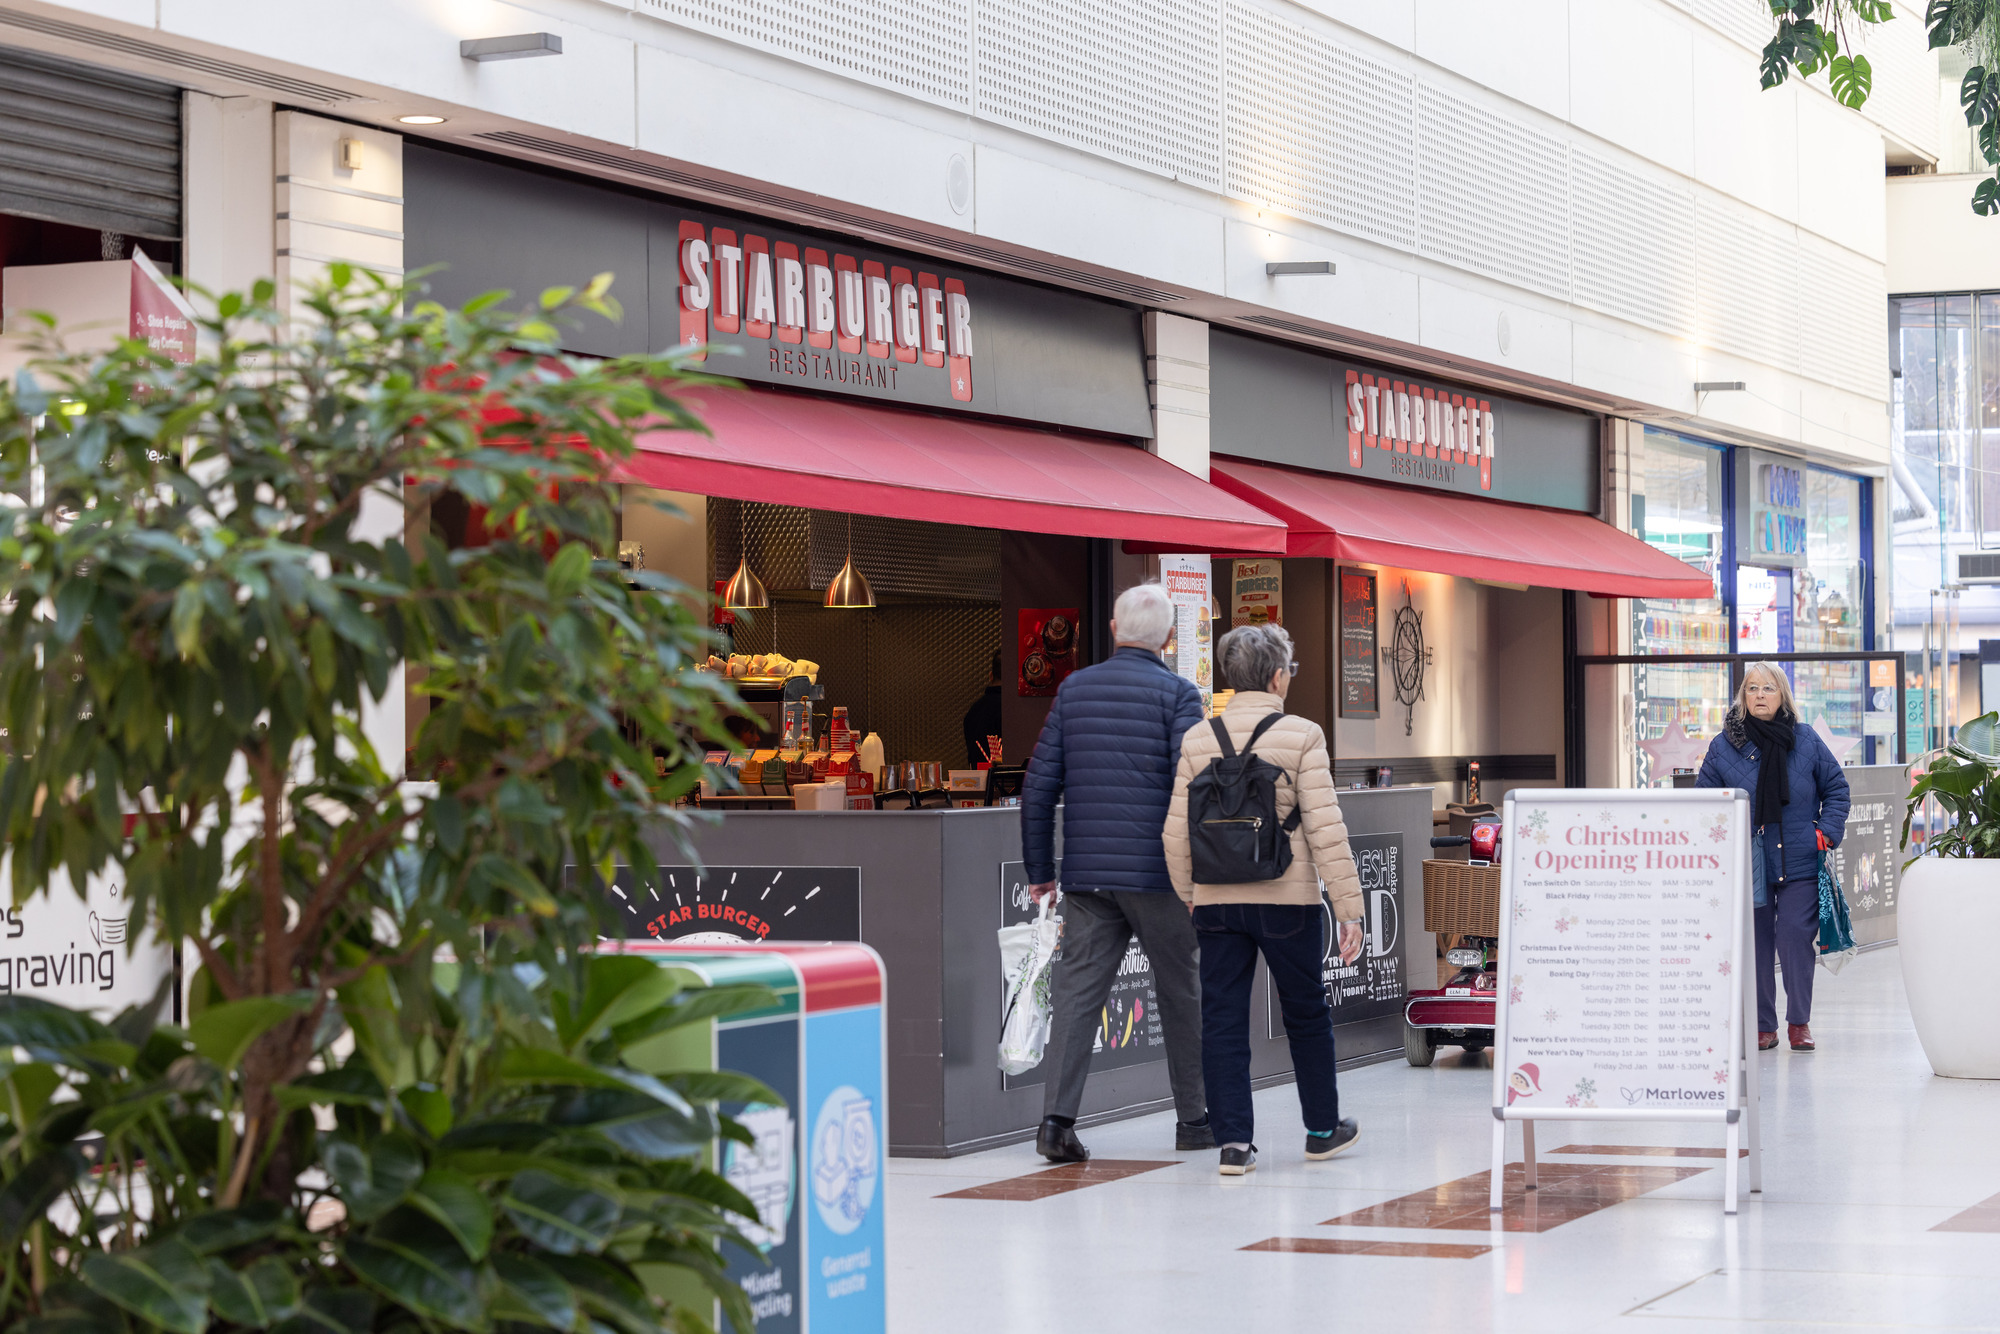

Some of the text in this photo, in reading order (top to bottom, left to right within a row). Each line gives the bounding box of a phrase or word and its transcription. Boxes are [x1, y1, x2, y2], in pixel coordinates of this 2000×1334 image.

[681, 238, 974, 357] STARBURGER
[148, 314, 187, 331] Shoe Repairs
[148, 336, 183, 351] Key Cutting
[769, 348, 899, 391] RESTAURANT
[1347, 381, 1495, 458] STARBURGER
[1391, 456, 1456, 484] RESTAURANT
[1237, 564, 1259, 577] Best
[1167, 575, 1207, 593] STARBURGER
[1236, 577, 1279, 595] BURGERS
[1565, 825, 1689, 846] Christmas
[1534, 849, 1720, 874] Opening Hours
[1584, 880, 1618, 888] Saturday
[1567, 893, 1590, 901] Friday
[1594, 893, 1617, 901] Friday
[646, 904, 771, 939] STAR BURGER
[1586, 919, 1615, 927] Monday
[1586, 931, 1615, 940] Tuesday
[1574, 944, 1616, 953] Wednesday
[1617, 944, 1635, 952] 24th
[1328, 956, 1345, 967] TRY
[1366, 933, 1374, 1000] ENJOY!
[1373, 956, 1399, 971] YUMMY
[1527, 957, 1564, 965] Christmas
[1566, 958, 1580, 966] Day
[1582, 957, 1615, 966] Thursday
[1617, 957, 1634, 965] 25th
[1380, 969, 1397, 984] EAT
[1550, 971, 1574, 979] Boxing
[1576, 971, 1589, 979] Day
[1592, 971, 1615, 979] Friday
[1343, 985, 1366, 997] TODAY!
[1376, 983, 1402, 1001] HERE!
[1580, 984, 1614, 992] Saturday
[1585, 997, 1612, 1005] Sunday
[1582, 1010, 1611, 1018] Monday
[1581, 1023, 1611, 1032] Tuesday
[1570, 1036, 1611, 1045] Wednesday
[1570, 1050, 1584, 1058] Day
[1586, 1050, 1620, 1058] Thursday
[1594, 1063, 1617, 1072] Friday
[1646, 1088, 1725, 1100] Marlowes
[821, 1247, 871, 1278] General
[827, 1269, 868, 1299] waste
